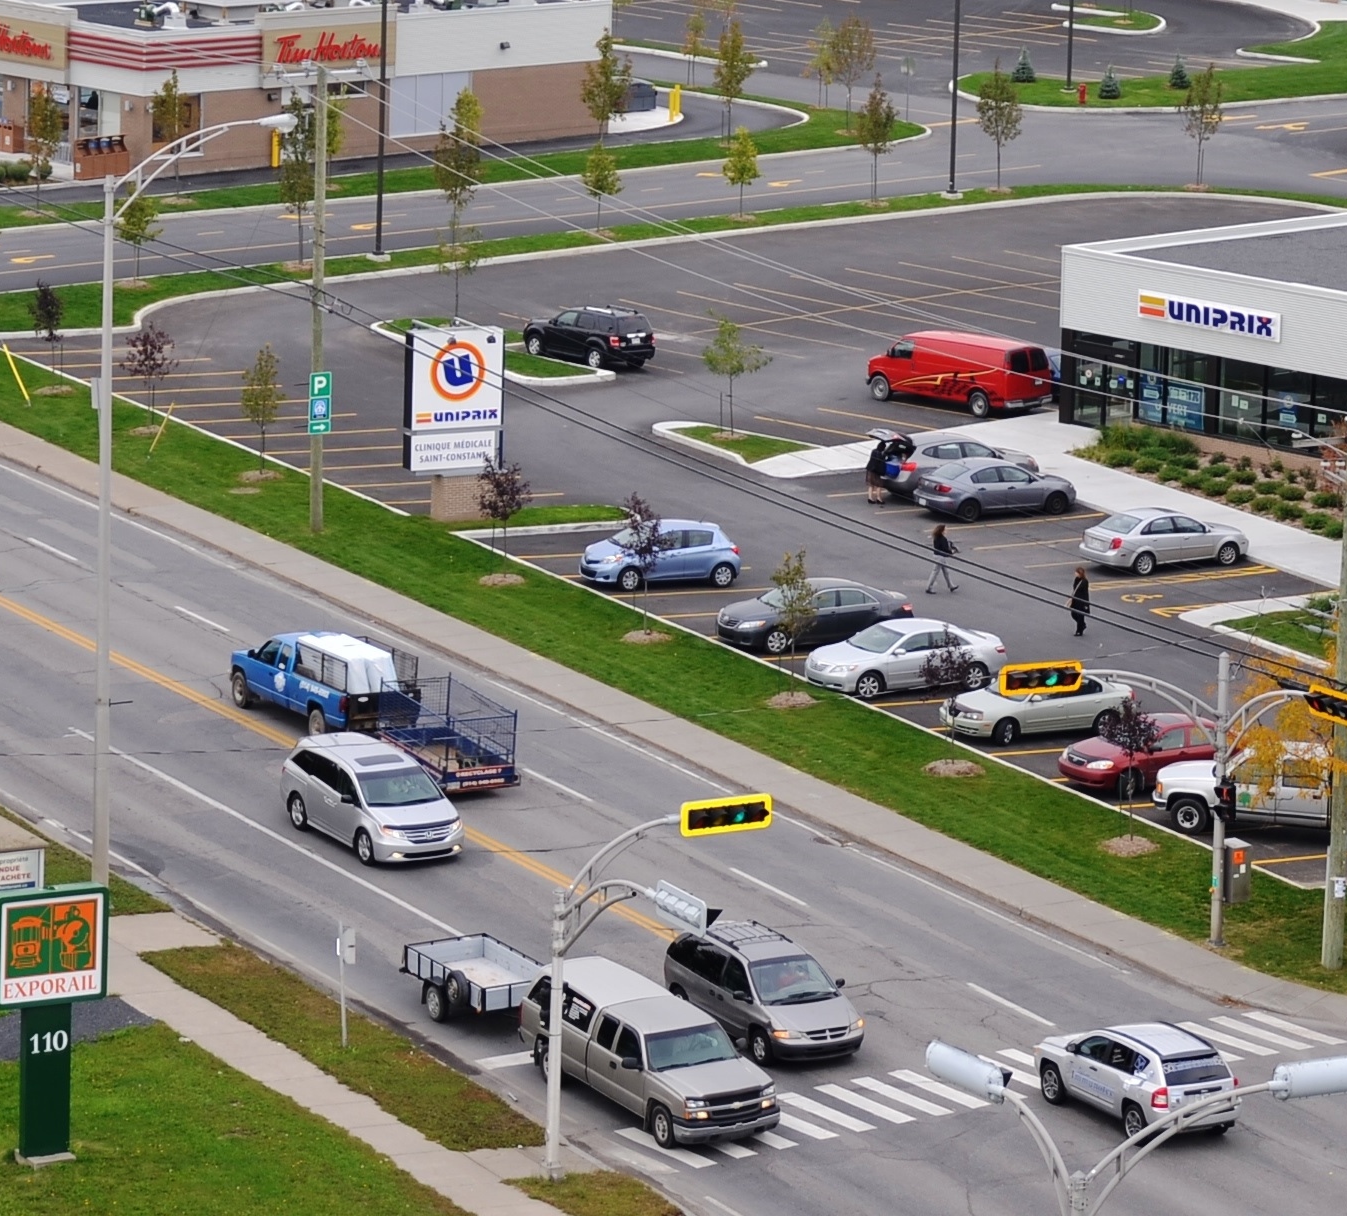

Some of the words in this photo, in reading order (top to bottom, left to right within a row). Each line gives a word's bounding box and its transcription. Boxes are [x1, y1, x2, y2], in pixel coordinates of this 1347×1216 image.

[273, 34, 311, 63] Tim
[311, 31, 381, 62] Horton
[1168, 299, 1273, 337] UNIPRIX
[314, 376, 327, 395] P
[433, 408, 499, 423] UNIPRIX
[1154, 401, 1188, 417] OVERT
[414, 441, 451, 452] CLINIQUE
[453, 438, 493, 450] MÉDICALE
[419, 450, 488, 464] SAINT-CONSTANT
[0, 855, 29, 866] propriété
[3, 974, 97, 999] EXPORAIL
[29, 1029, 69, 1055] 110
